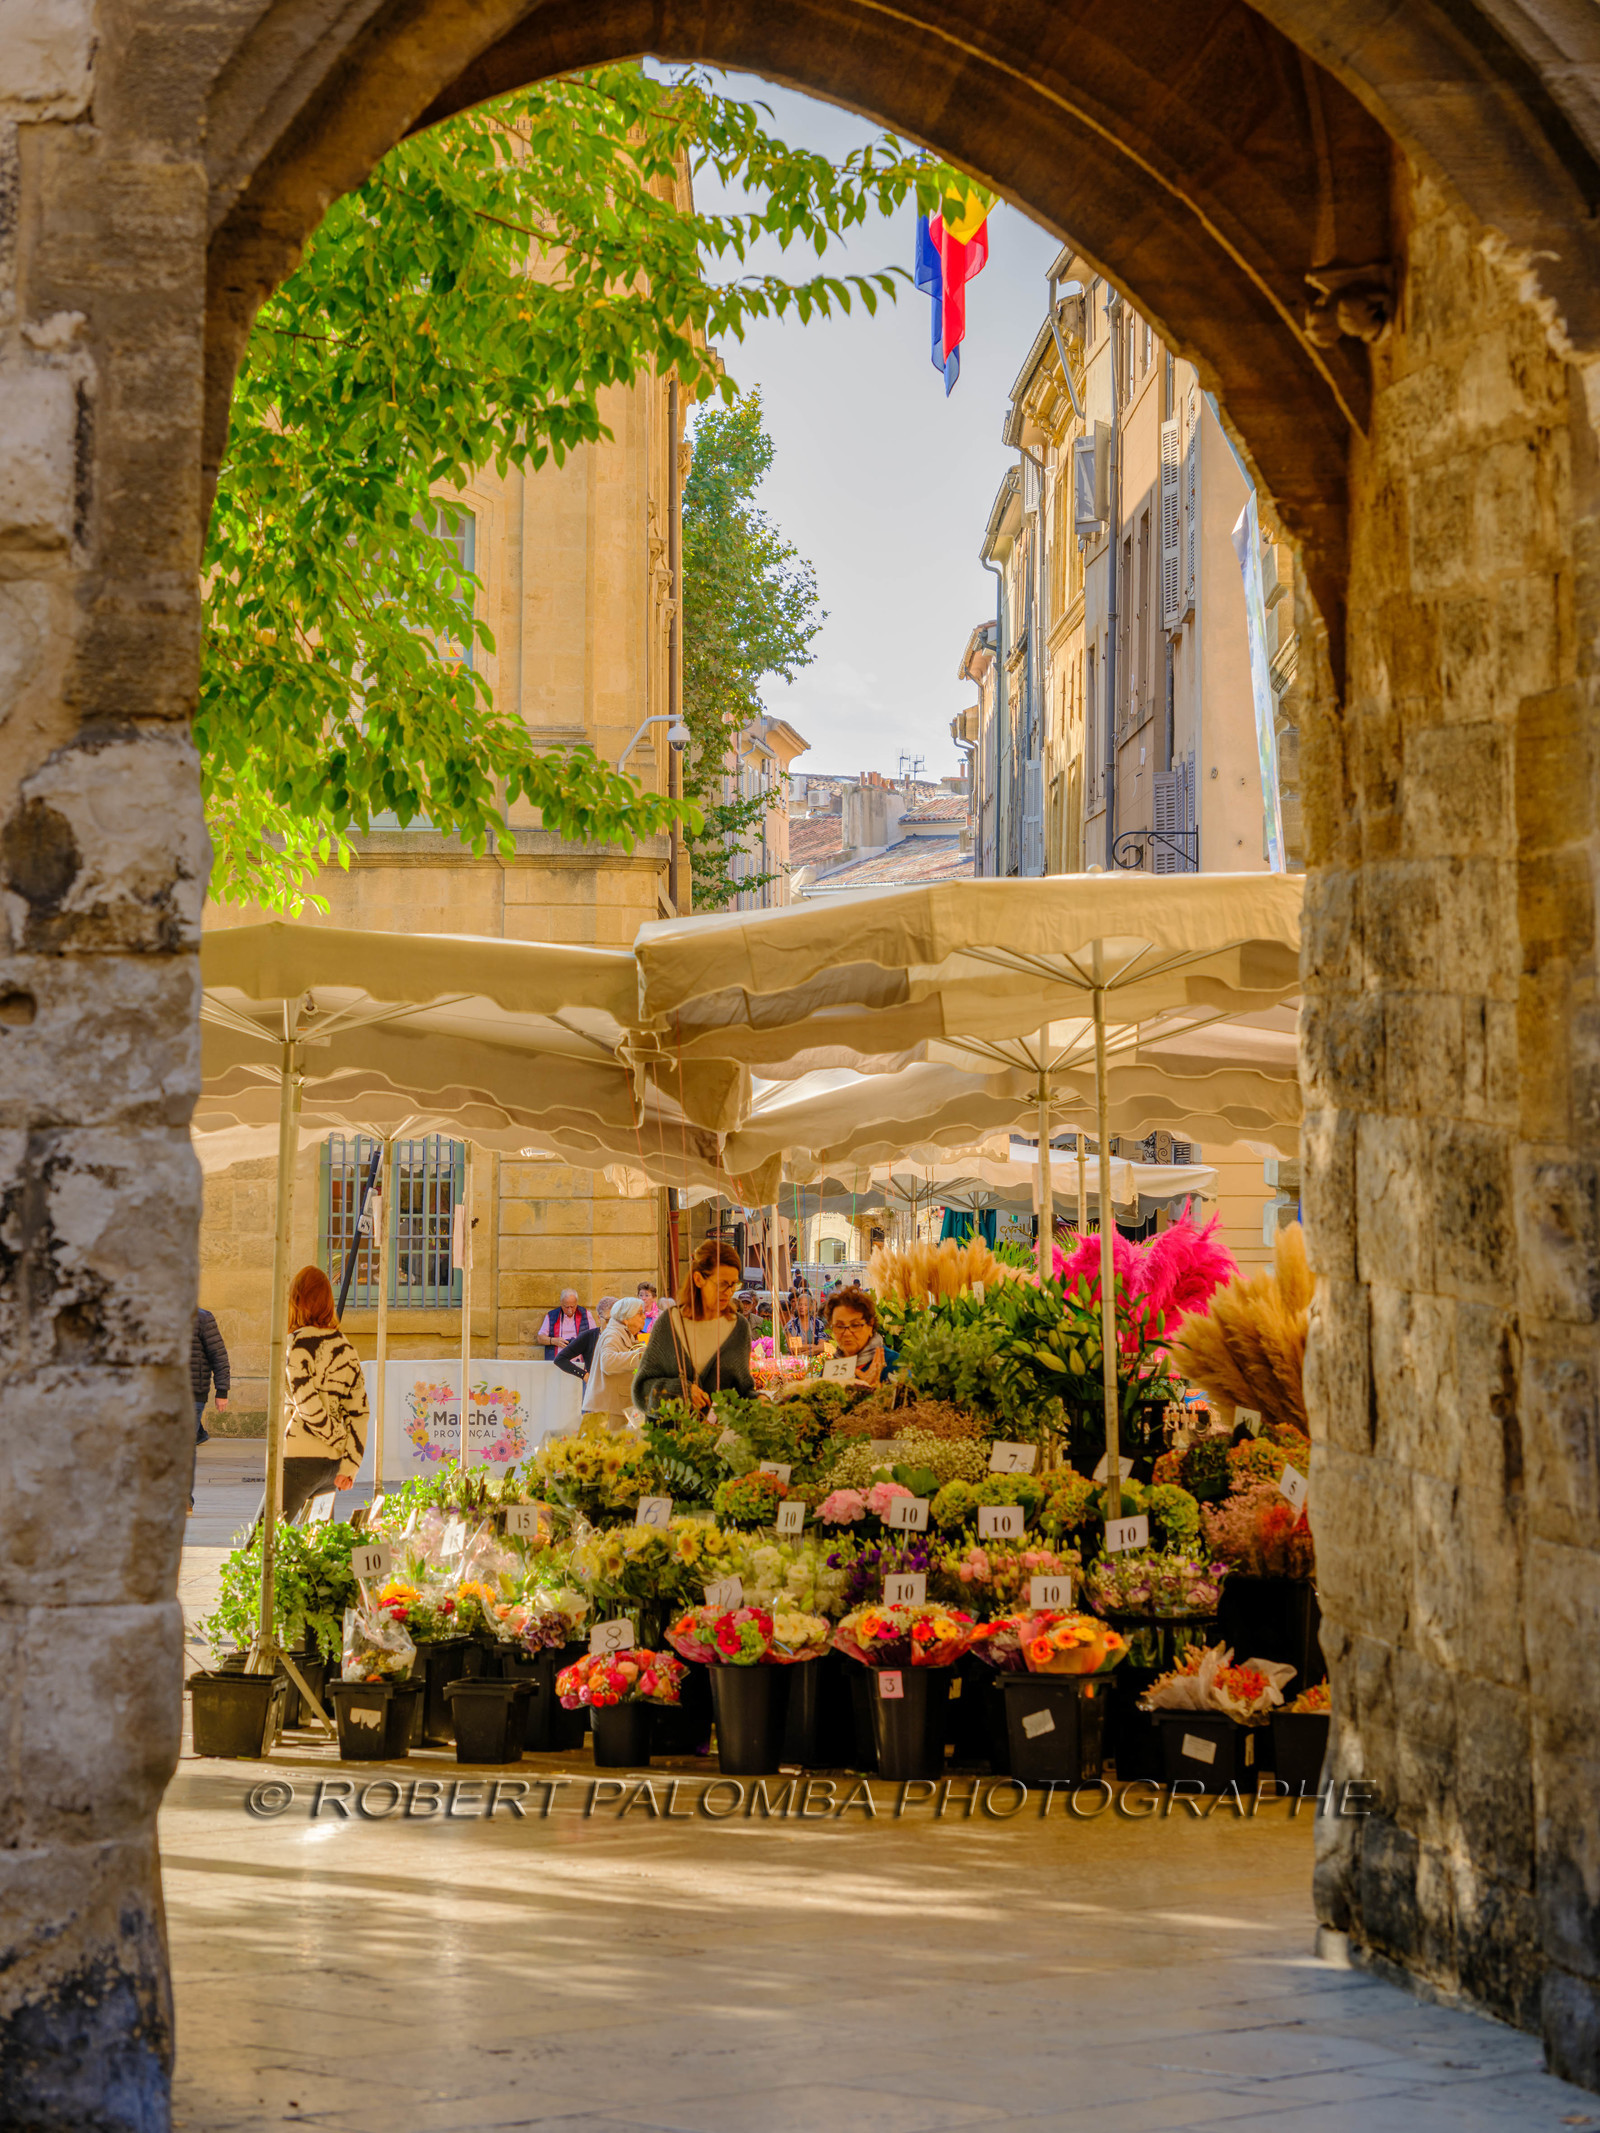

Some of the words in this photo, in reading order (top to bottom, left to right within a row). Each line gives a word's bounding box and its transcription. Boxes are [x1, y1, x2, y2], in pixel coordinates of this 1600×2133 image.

[832, 1363, 848, 1376] 25
[433, 1409, 498, 1426] Maché
[434, 1429, 497, 1439] PROVNÇAL
[516, 1513, 531, 1529] 15
[784, 1511, 797, 1527] 10
[900, 1506, 918, 1524] 10
[991, 1516, 1011, 1533] 10
[1118, 1526, 1137, 1545] 10
[364, 1553, 382, 1571] 10
[896, 1583, 914, 1601] 10
[1043, 1585, 1060, 1603] 10
[605, 1625, 622, 1649] 8
[884, 1678, 895, 1693] 3
